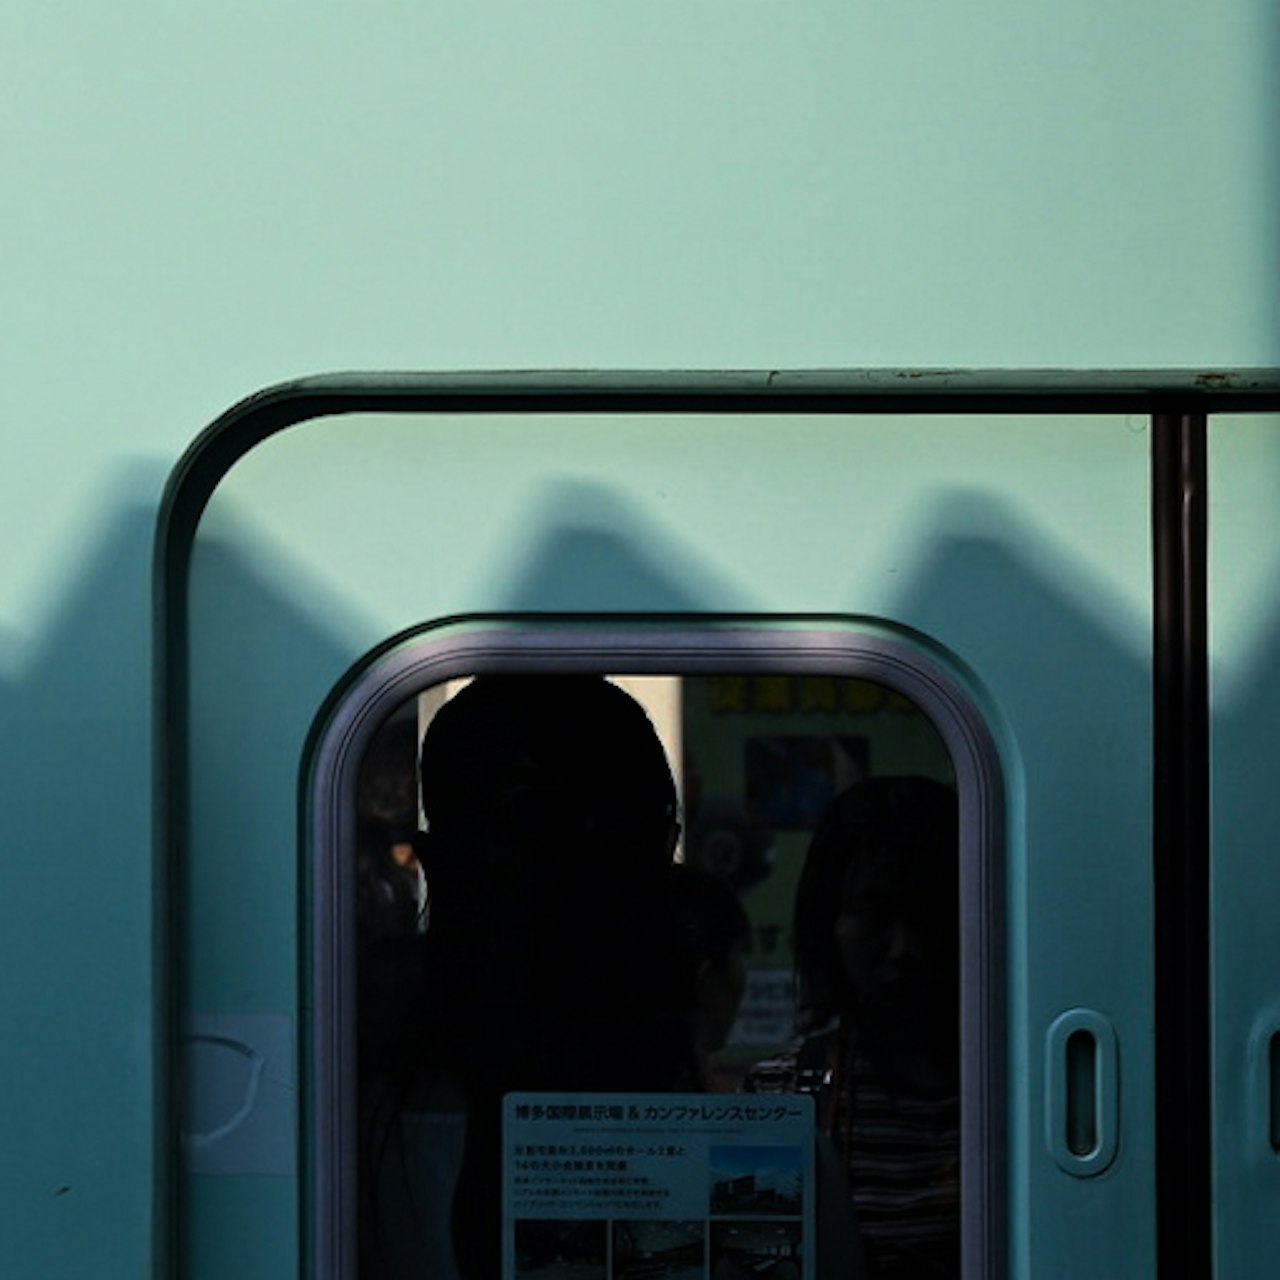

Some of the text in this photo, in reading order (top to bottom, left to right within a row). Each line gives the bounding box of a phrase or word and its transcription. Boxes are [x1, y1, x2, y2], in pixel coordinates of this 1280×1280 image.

[628, 1106, 640, 1122] &
[644, 1105, 802, 1122] カンファレンスセンター
